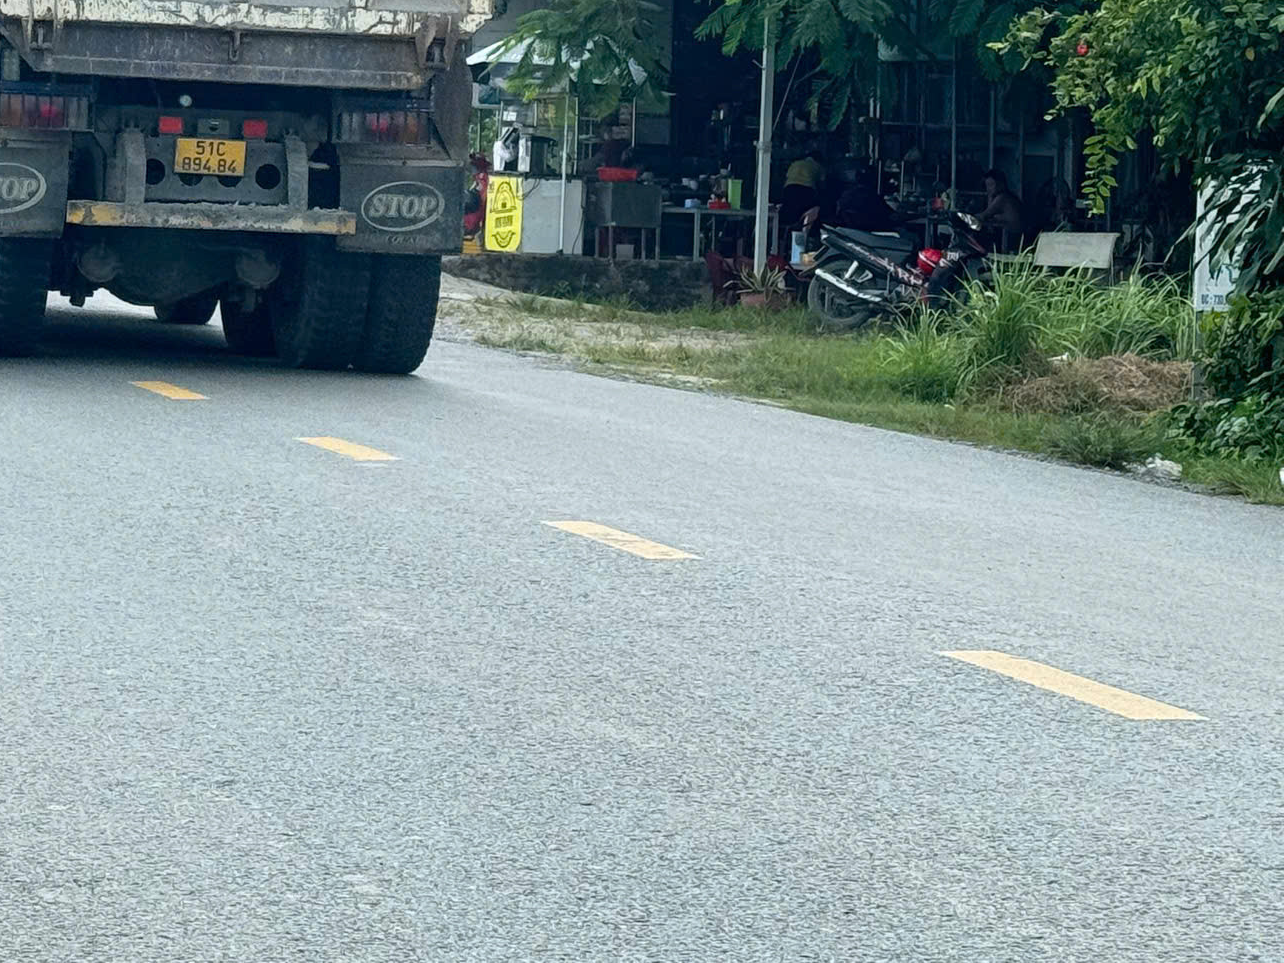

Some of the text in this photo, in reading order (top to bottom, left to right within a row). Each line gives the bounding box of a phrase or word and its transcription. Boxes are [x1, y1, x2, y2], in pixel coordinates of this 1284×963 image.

[196, 141, 226, 156] 51C
[182, 157, 237, 173] 894.84
[369, 194, 437, 219] STOP
